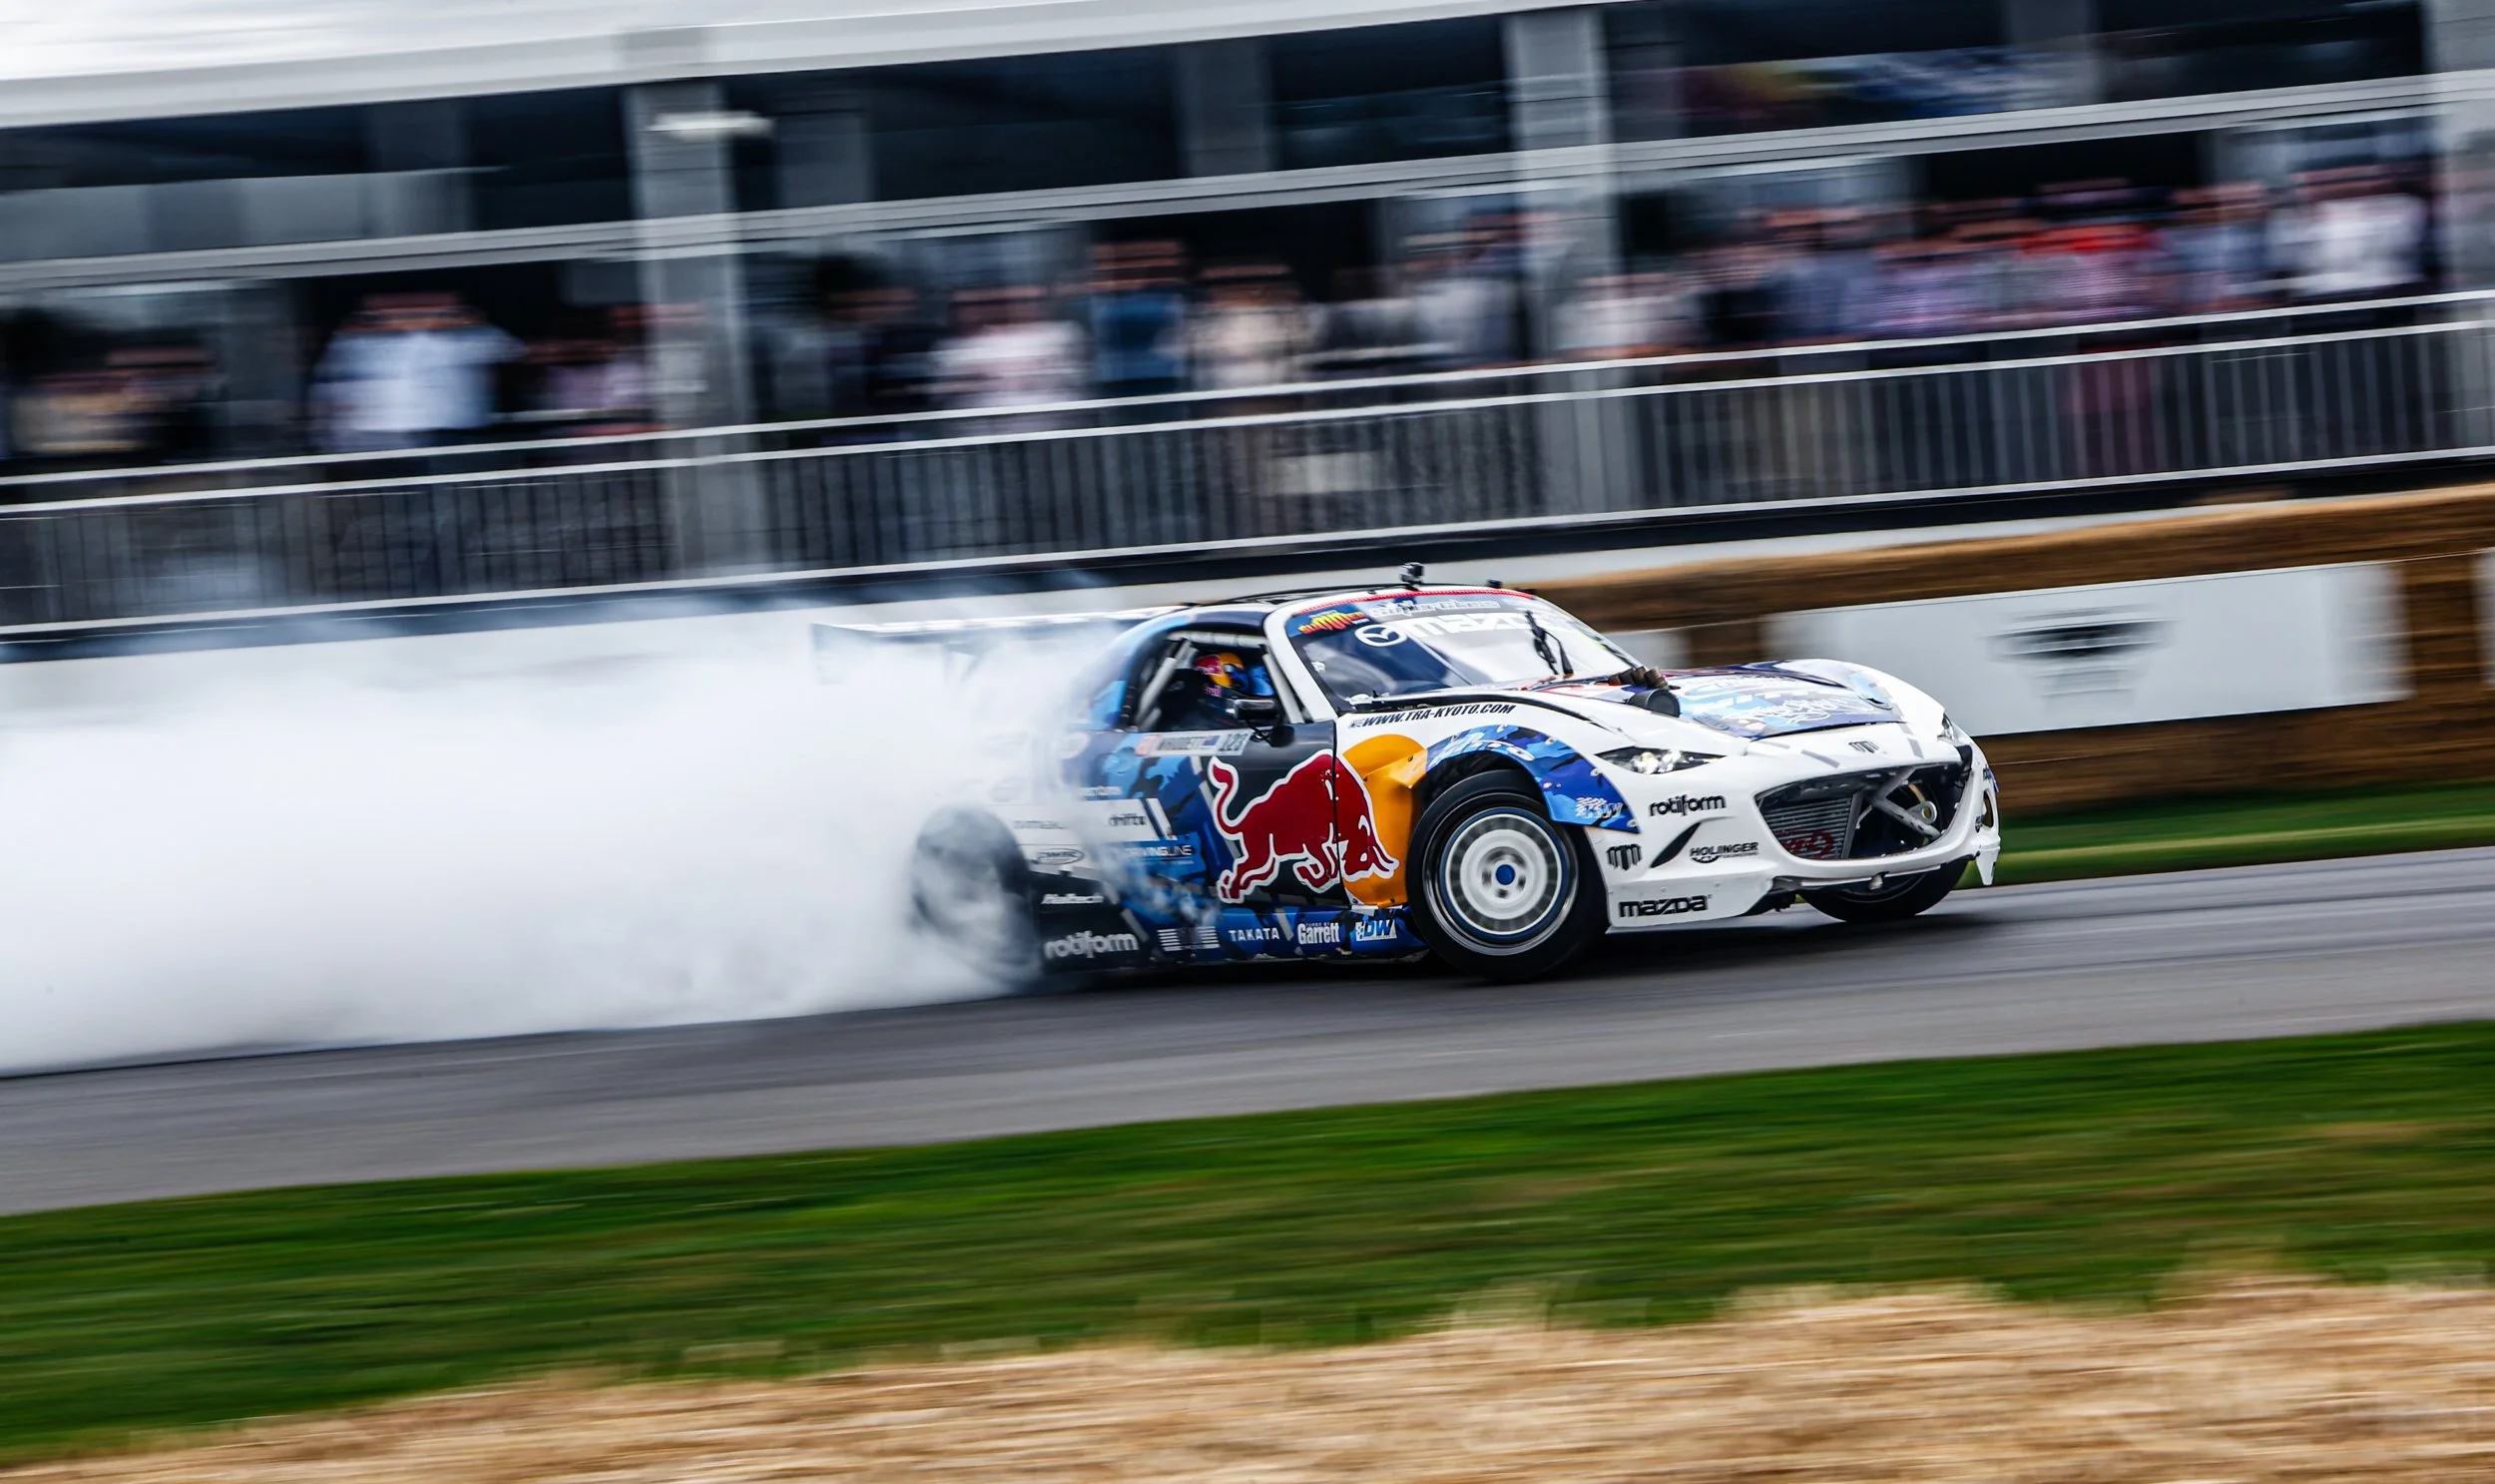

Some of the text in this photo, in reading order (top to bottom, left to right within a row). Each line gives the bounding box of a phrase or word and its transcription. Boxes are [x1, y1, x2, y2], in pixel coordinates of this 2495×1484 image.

[1362, 703, 1516, 728] WWW.TRA-KYOTO.COM
[1649, 794, 1727, 816] rotiform
[1690, 841, 1758, 857] HOLINGER
[1619, 895, 1709, 918] mazda
[1044, 930, 1140, 960] rotiform
[1229, 927, 1279, 942] TAKATA
[1297, 922, 1340, 945] Garrett
